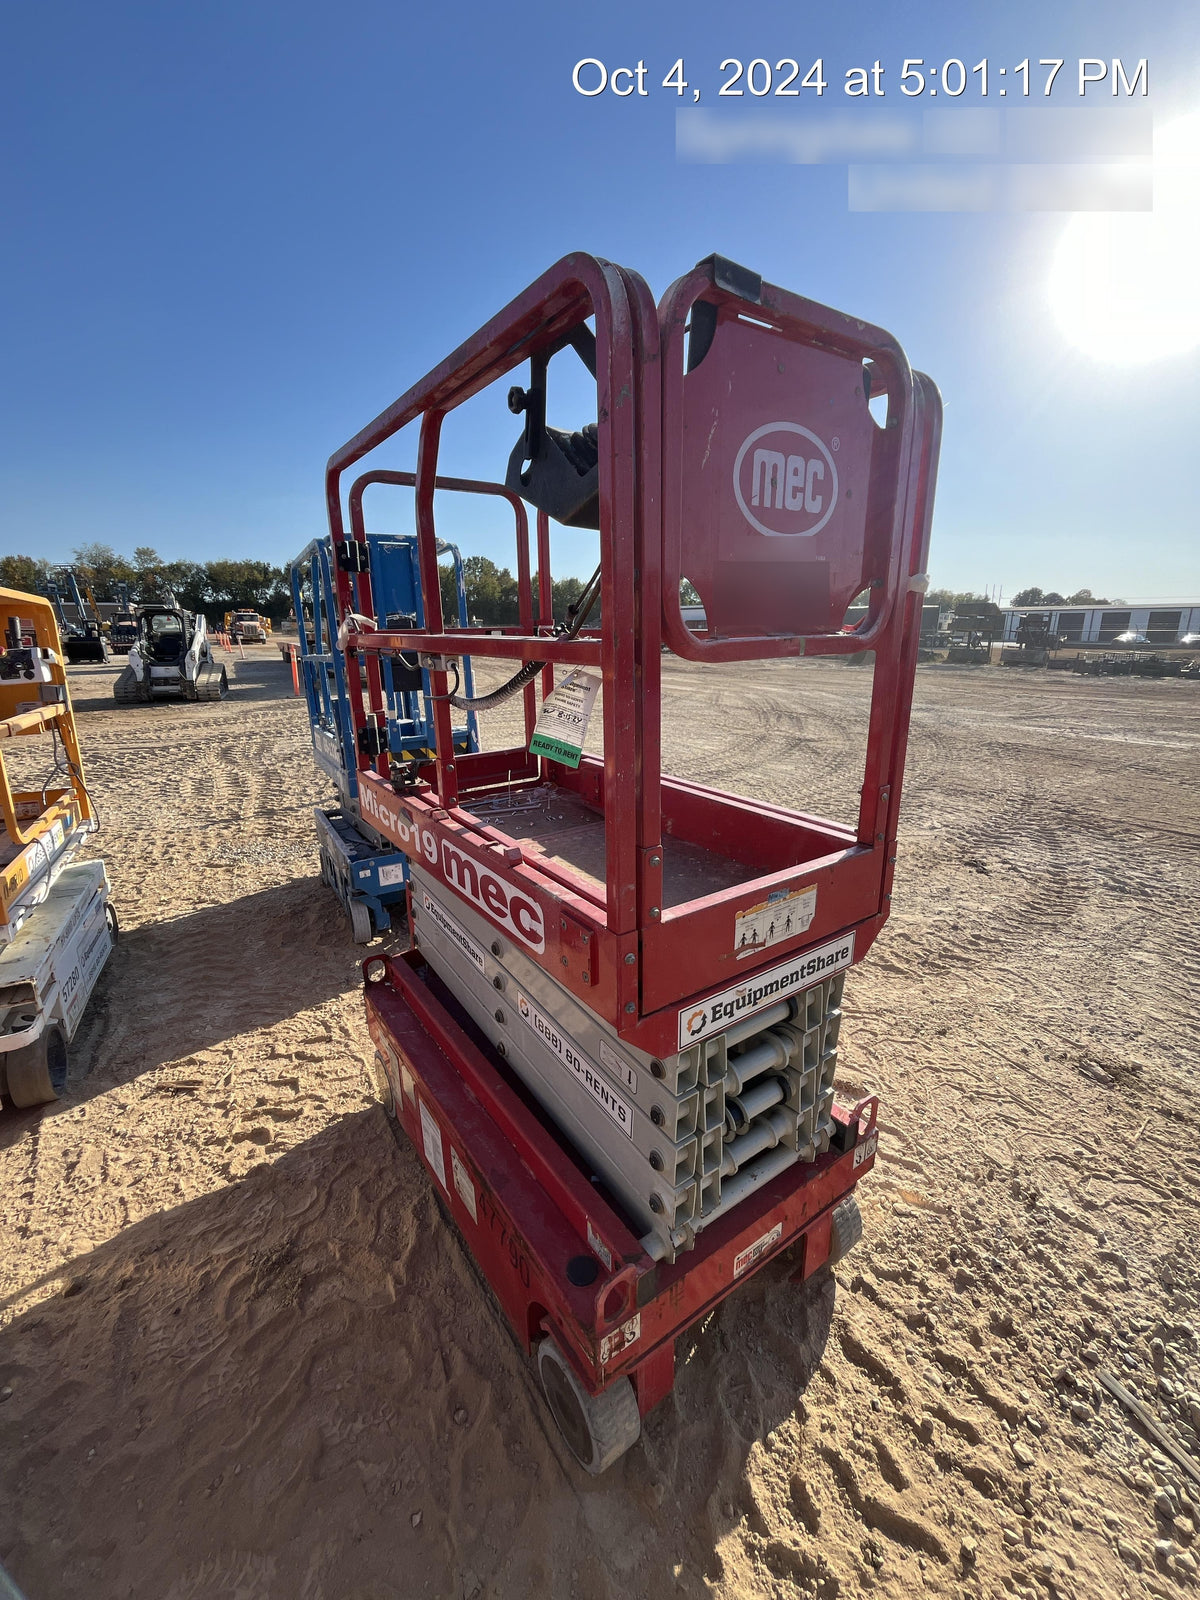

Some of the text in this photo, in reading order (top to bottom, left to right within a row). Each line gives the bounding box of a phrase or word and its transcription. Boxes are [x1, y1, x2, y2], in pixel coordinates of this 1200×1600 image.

[532, 739, 579, 761] READY TO RENT
[429, 901, 484, 968] EquipmentShare
[710, 946, 849, 1024] EquipmentShare
[565, 1048, 627, 1123] 80-RENTS
